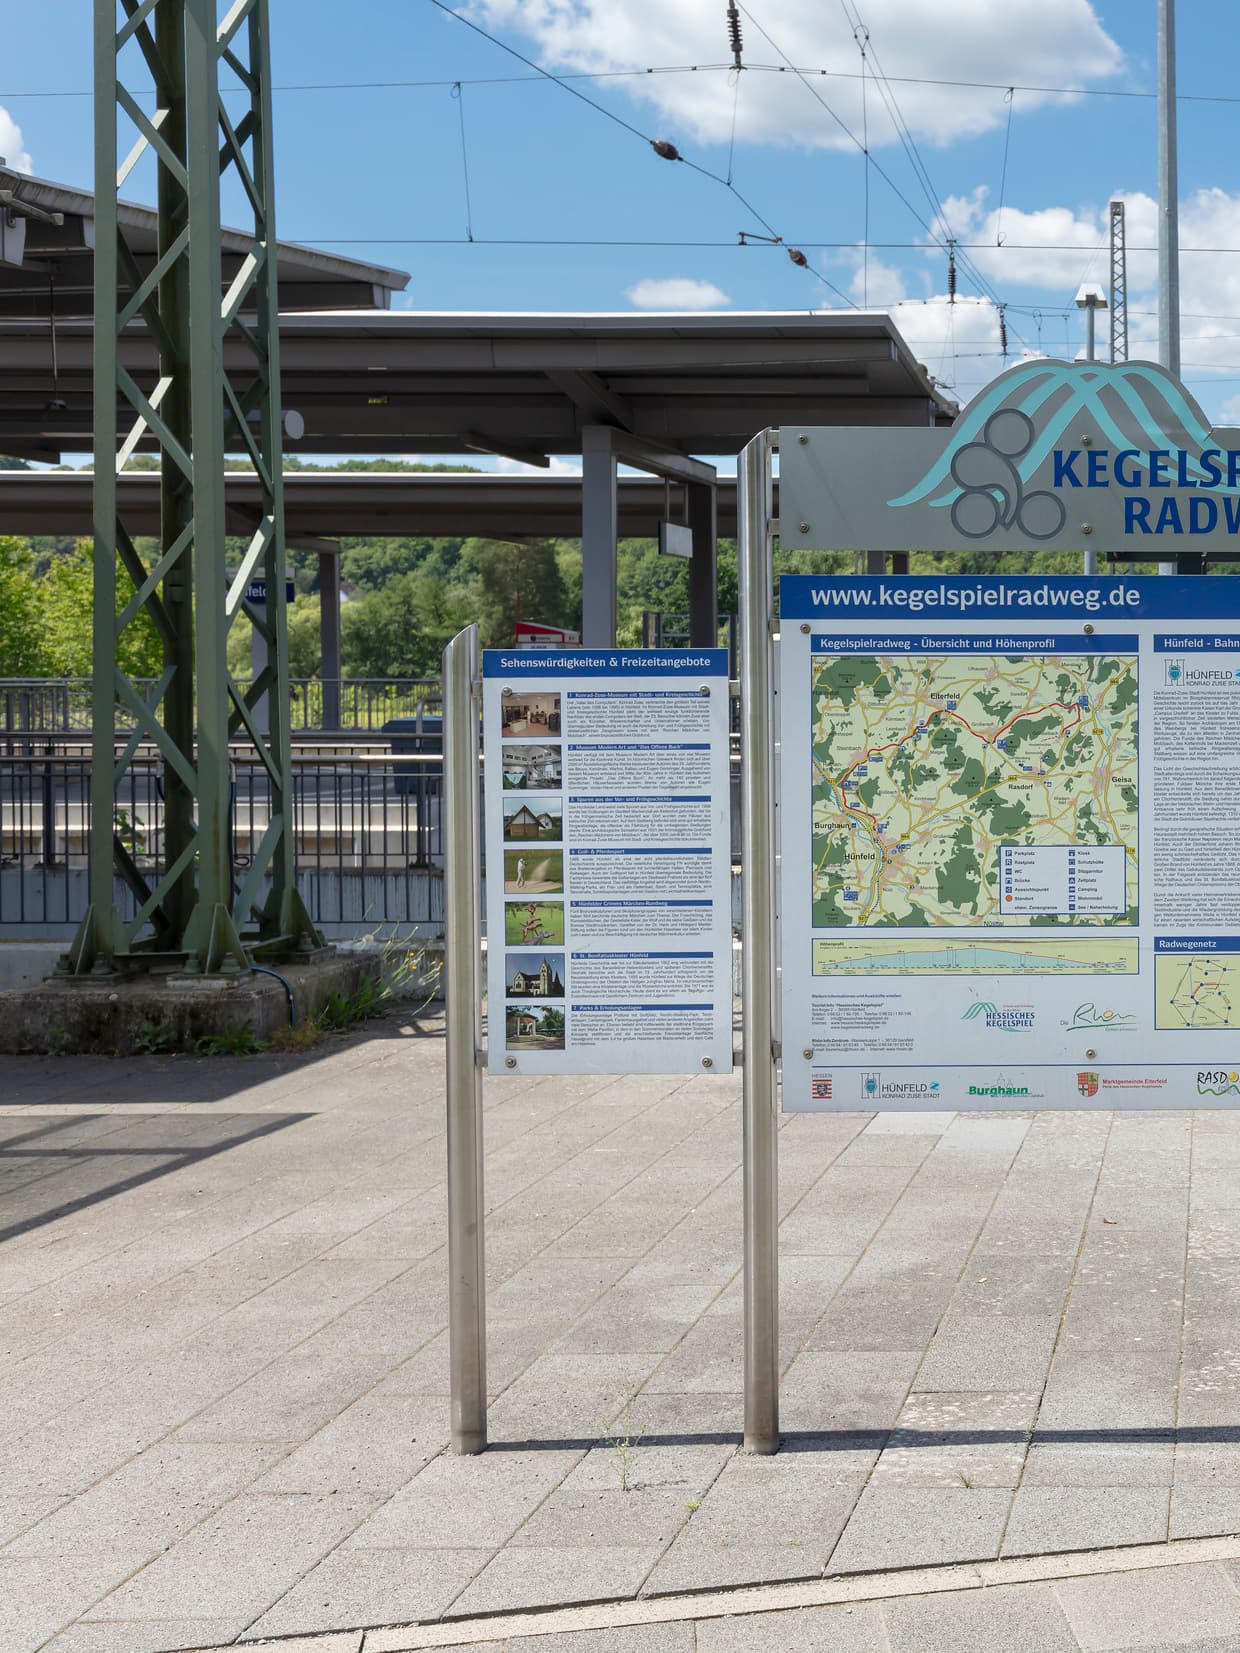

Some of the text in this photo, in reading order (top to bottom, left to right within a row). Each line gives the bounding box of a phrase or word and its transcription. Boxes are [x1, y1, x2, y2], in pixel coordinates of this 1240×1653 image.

[811, 585, 1140, 610] www.kegelspielradweg.de
[820, 638, 910, 650] Kegelspielradweg
[922, 636, 970, 648] Übersicht
[973, 638, 992, 648] und
[995, 637, 1055, 650] Höhenprofil
[1164, 638, 1204, 648] Hünfeld
[500, 656, 711, 672] Sehenswürdigkeiten & Freizeitangebote
[1186, 670, 1233, 680] HÜNFELD
[930, 692, 960, 700] Eiterfeld
[1008, 782, 1033, 790] Rasdorf
[1159, 940, 1217, 952] Radwegenetz
[986, 1012, 1035, 1020] HESSISCHES
[986, 1020, 1033, 1028] KEGELSPIEL
[882, 1082, 928, 1092] HÜNFELD
[968, 1086, 1028, 1097] Burghaun
